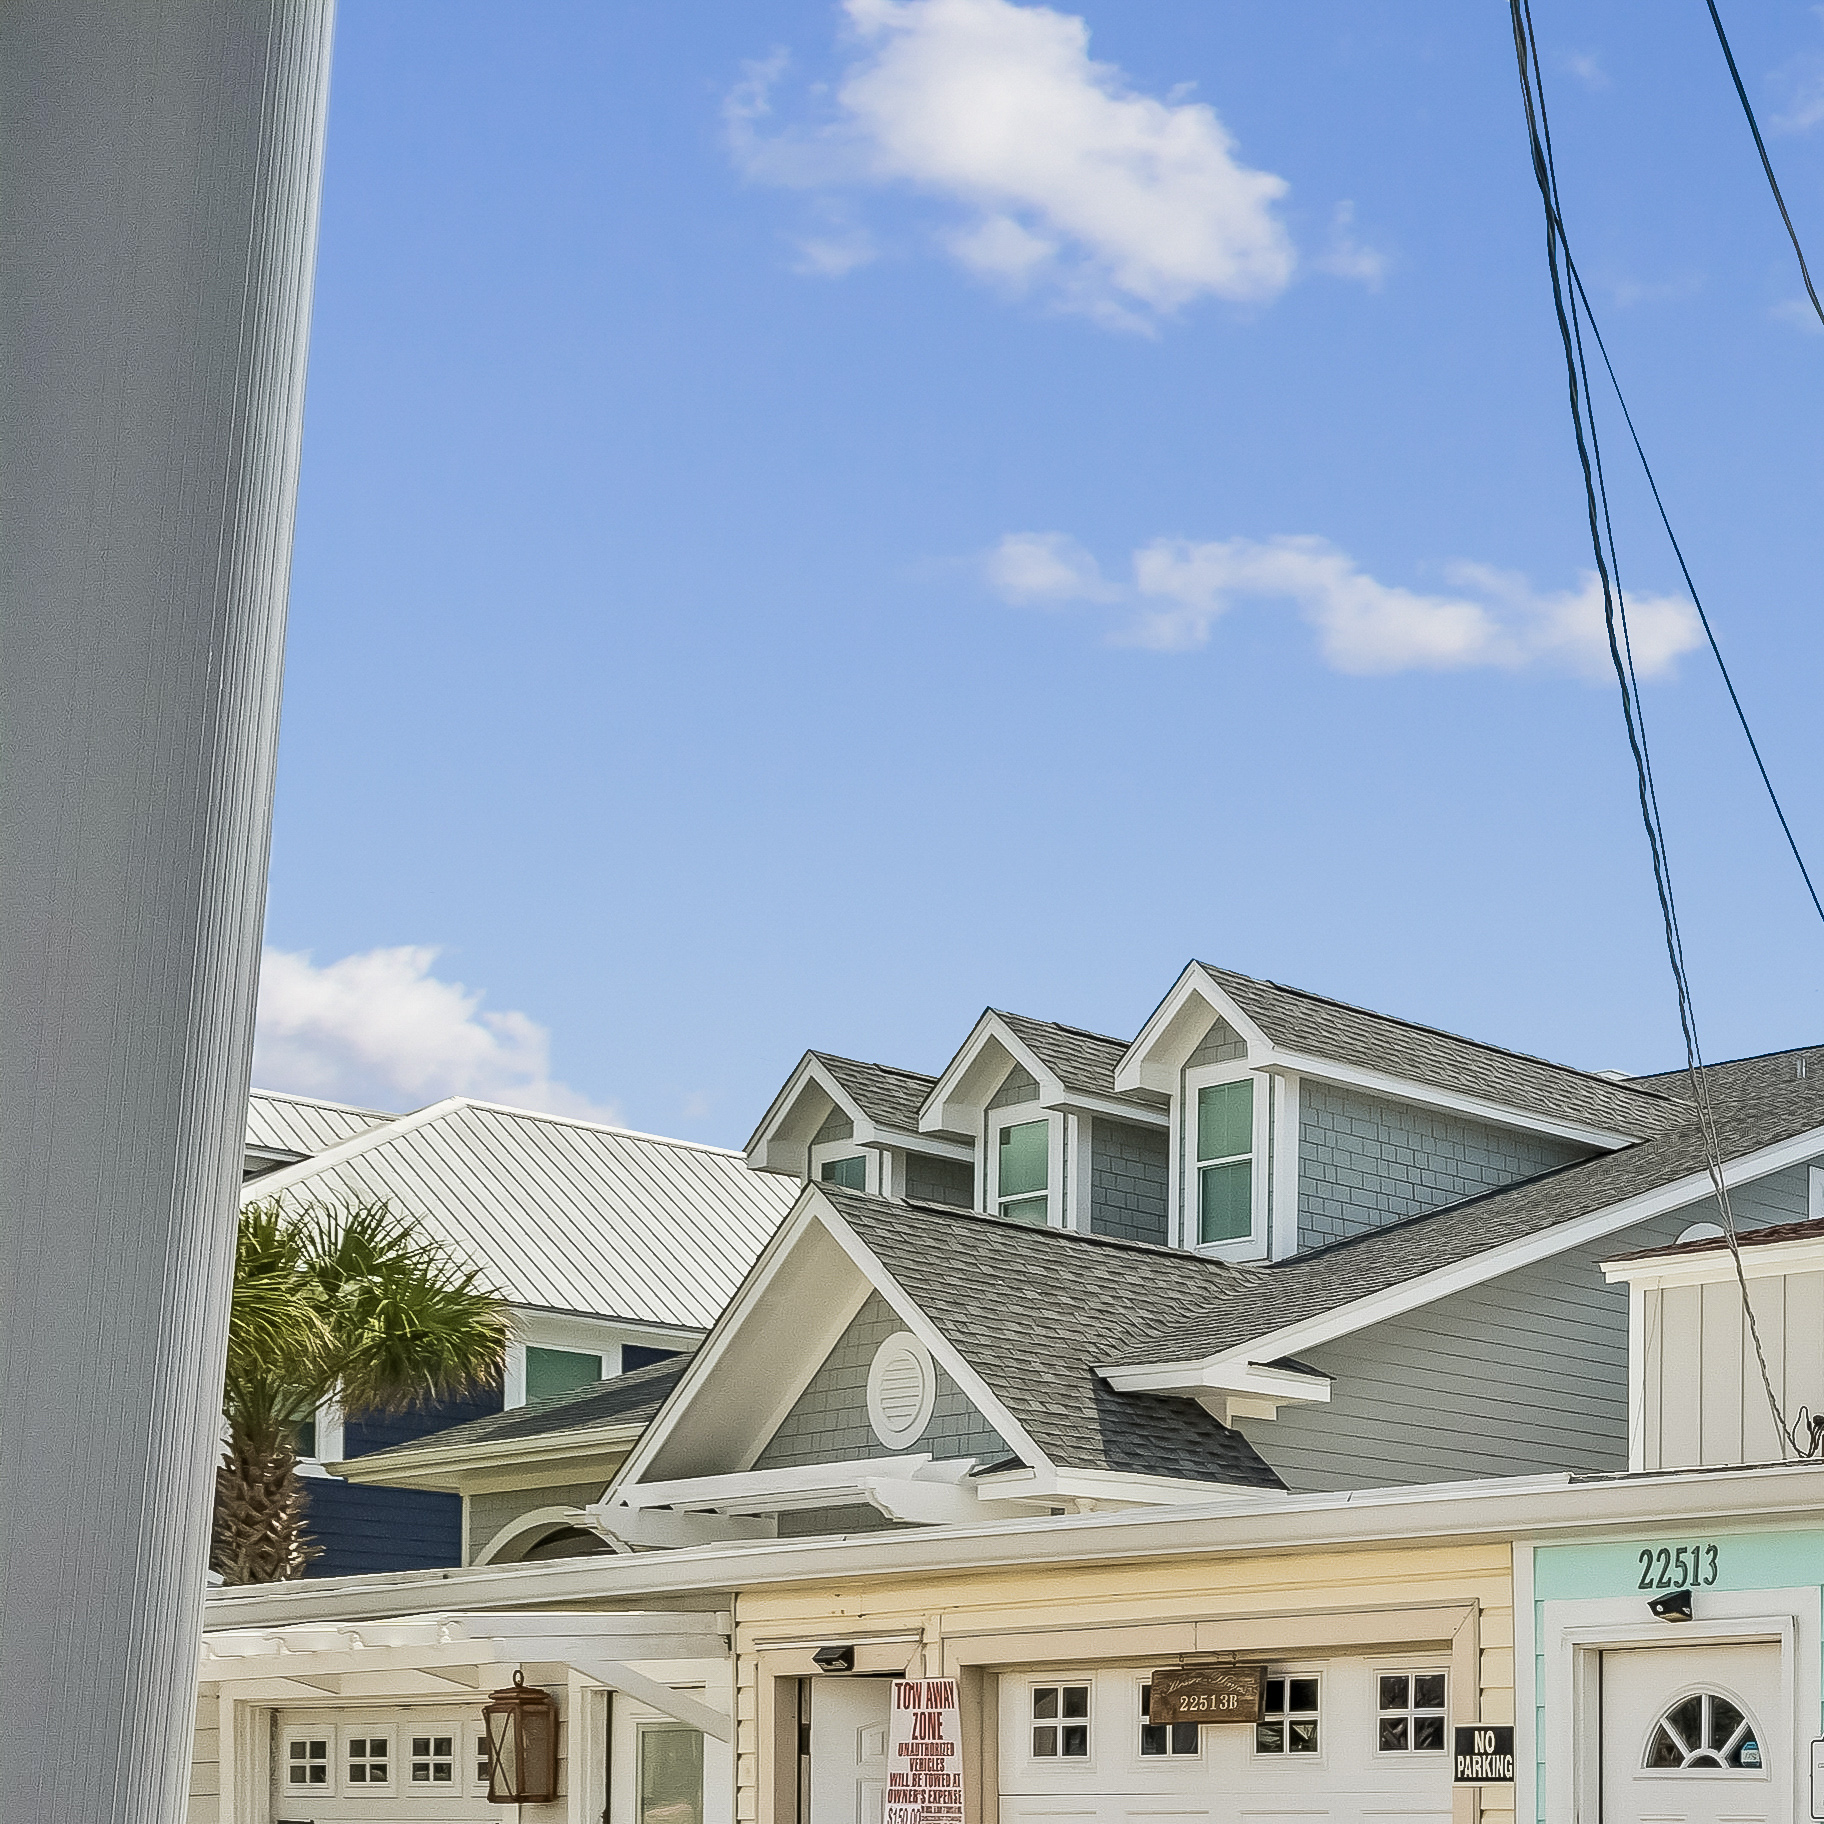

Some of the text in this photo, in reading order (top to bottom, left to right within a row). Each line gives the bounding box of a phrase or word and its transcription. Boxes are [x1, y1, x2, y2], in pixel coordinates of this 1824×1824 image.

[1638, 1544, 1718, 1590] 22513
[895, 1681, 954, 1709] TOW AWAY
[1180, 1695, 1237, 1711] 22513B
[912, 1712, 943, 1740] ZONE
[898, 1742, 954, 1756] UNAUTHORIZED
[1474, 1731, 1495, 1753] NO
[910, 1758, 944, 1772] VEHICLES
[1458, 1755, 1512, 1778] PARKING
[890, 1773, 960, 1787] WILL BE TOWED AT
[888, 1789, 962, 1804] OWNER'S EXPENSE
